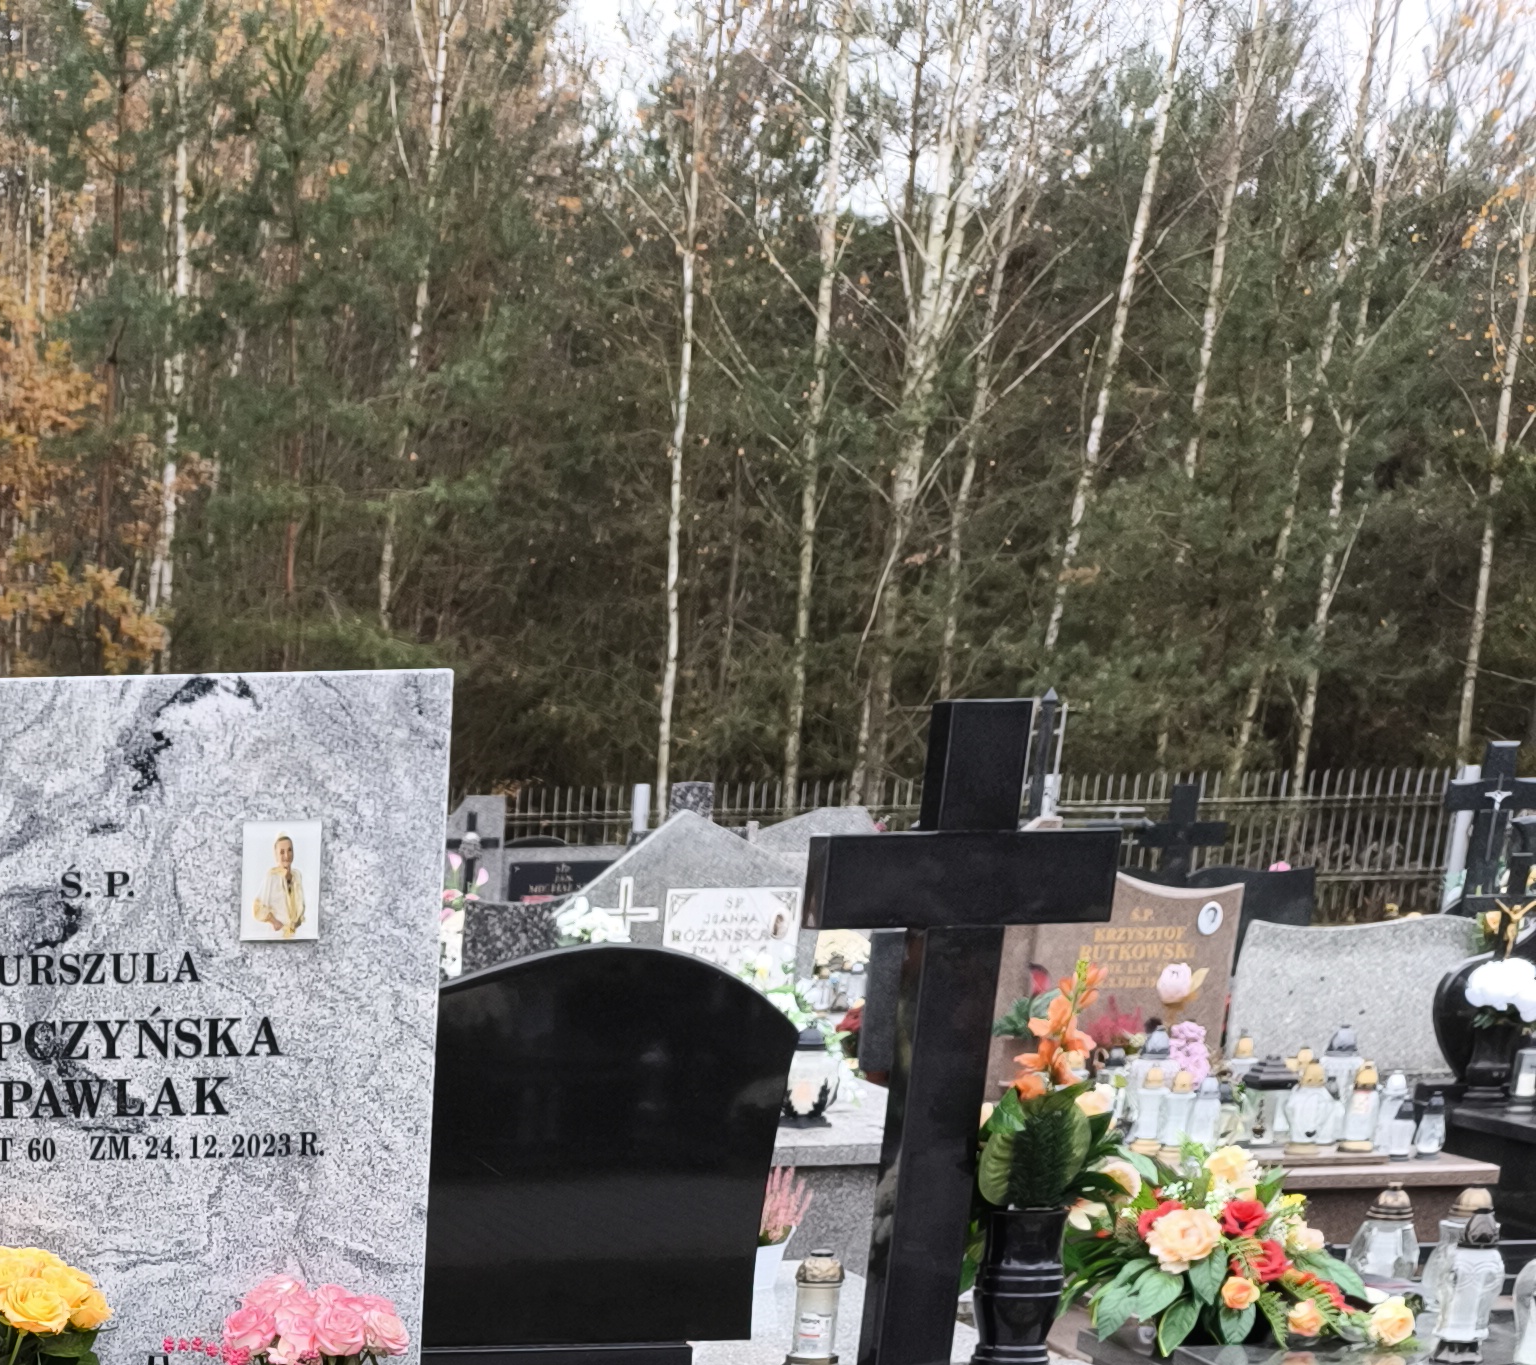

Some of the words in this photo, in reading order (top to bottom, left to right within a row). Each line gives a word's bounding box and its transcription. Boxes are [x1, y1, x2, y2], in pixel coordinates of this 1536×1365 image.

[0, 1076, 230, 1120] PAWLAK
[27, 1137, 56, 1163] 60
[89, 1135, 138, 1161] ZM.
[232, 1132, 292, 1158] 2023
